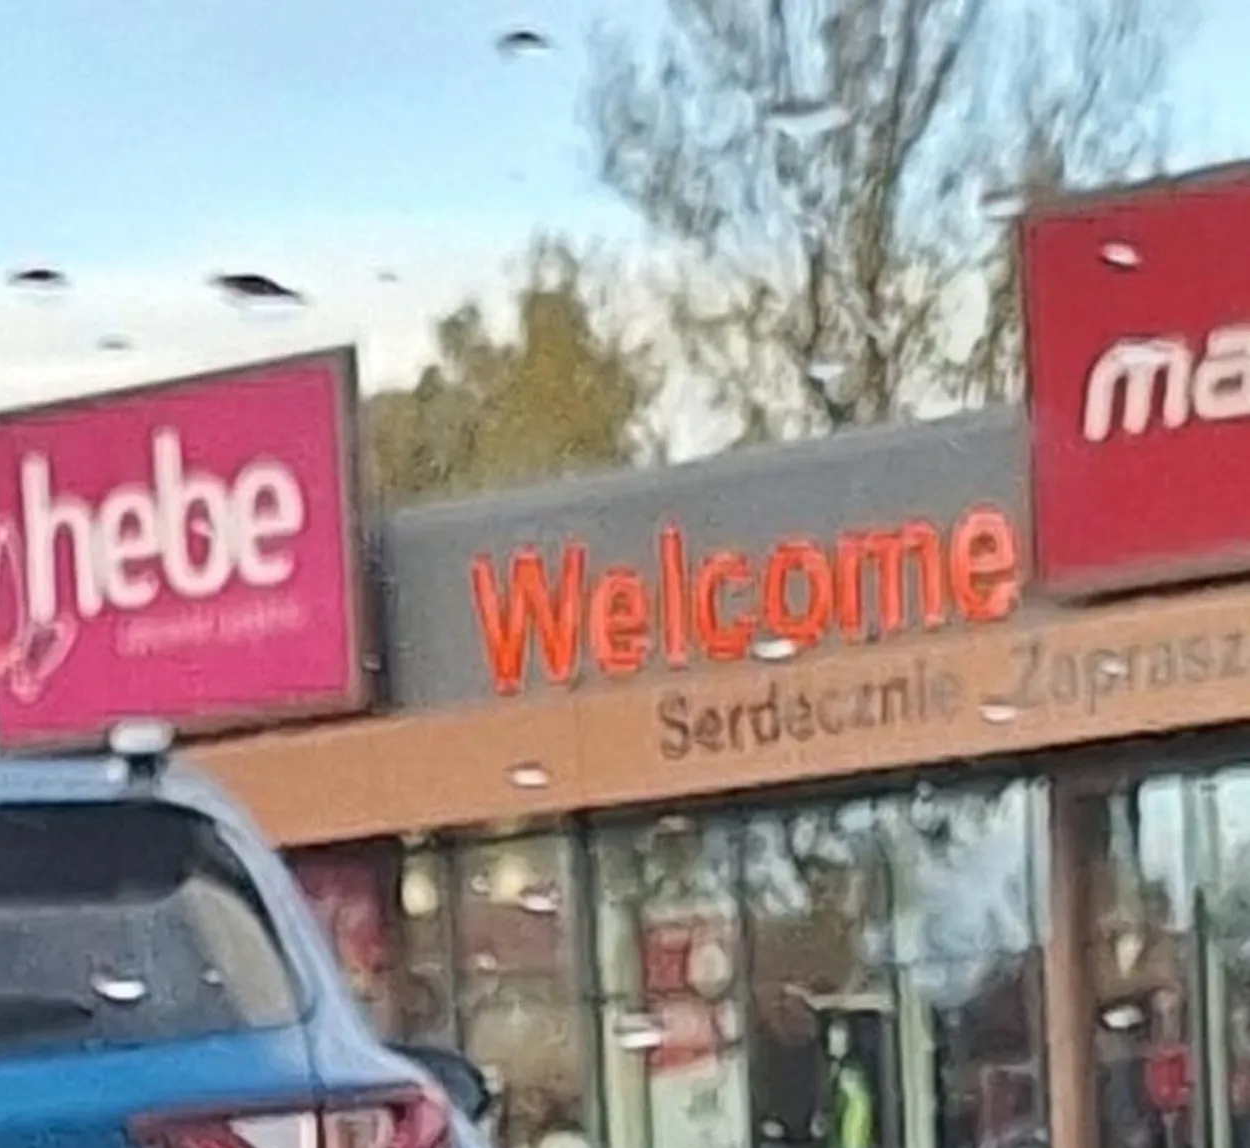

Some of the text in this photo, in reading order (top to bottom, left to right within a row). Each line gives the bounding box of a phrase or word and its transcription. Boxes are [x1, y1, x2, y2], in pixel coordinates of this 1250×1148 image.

[21, 426, 304, 621] hebe
[470, 505, 1018, 696] Welcome
[657, 658, 964, 761] Serdecznie
